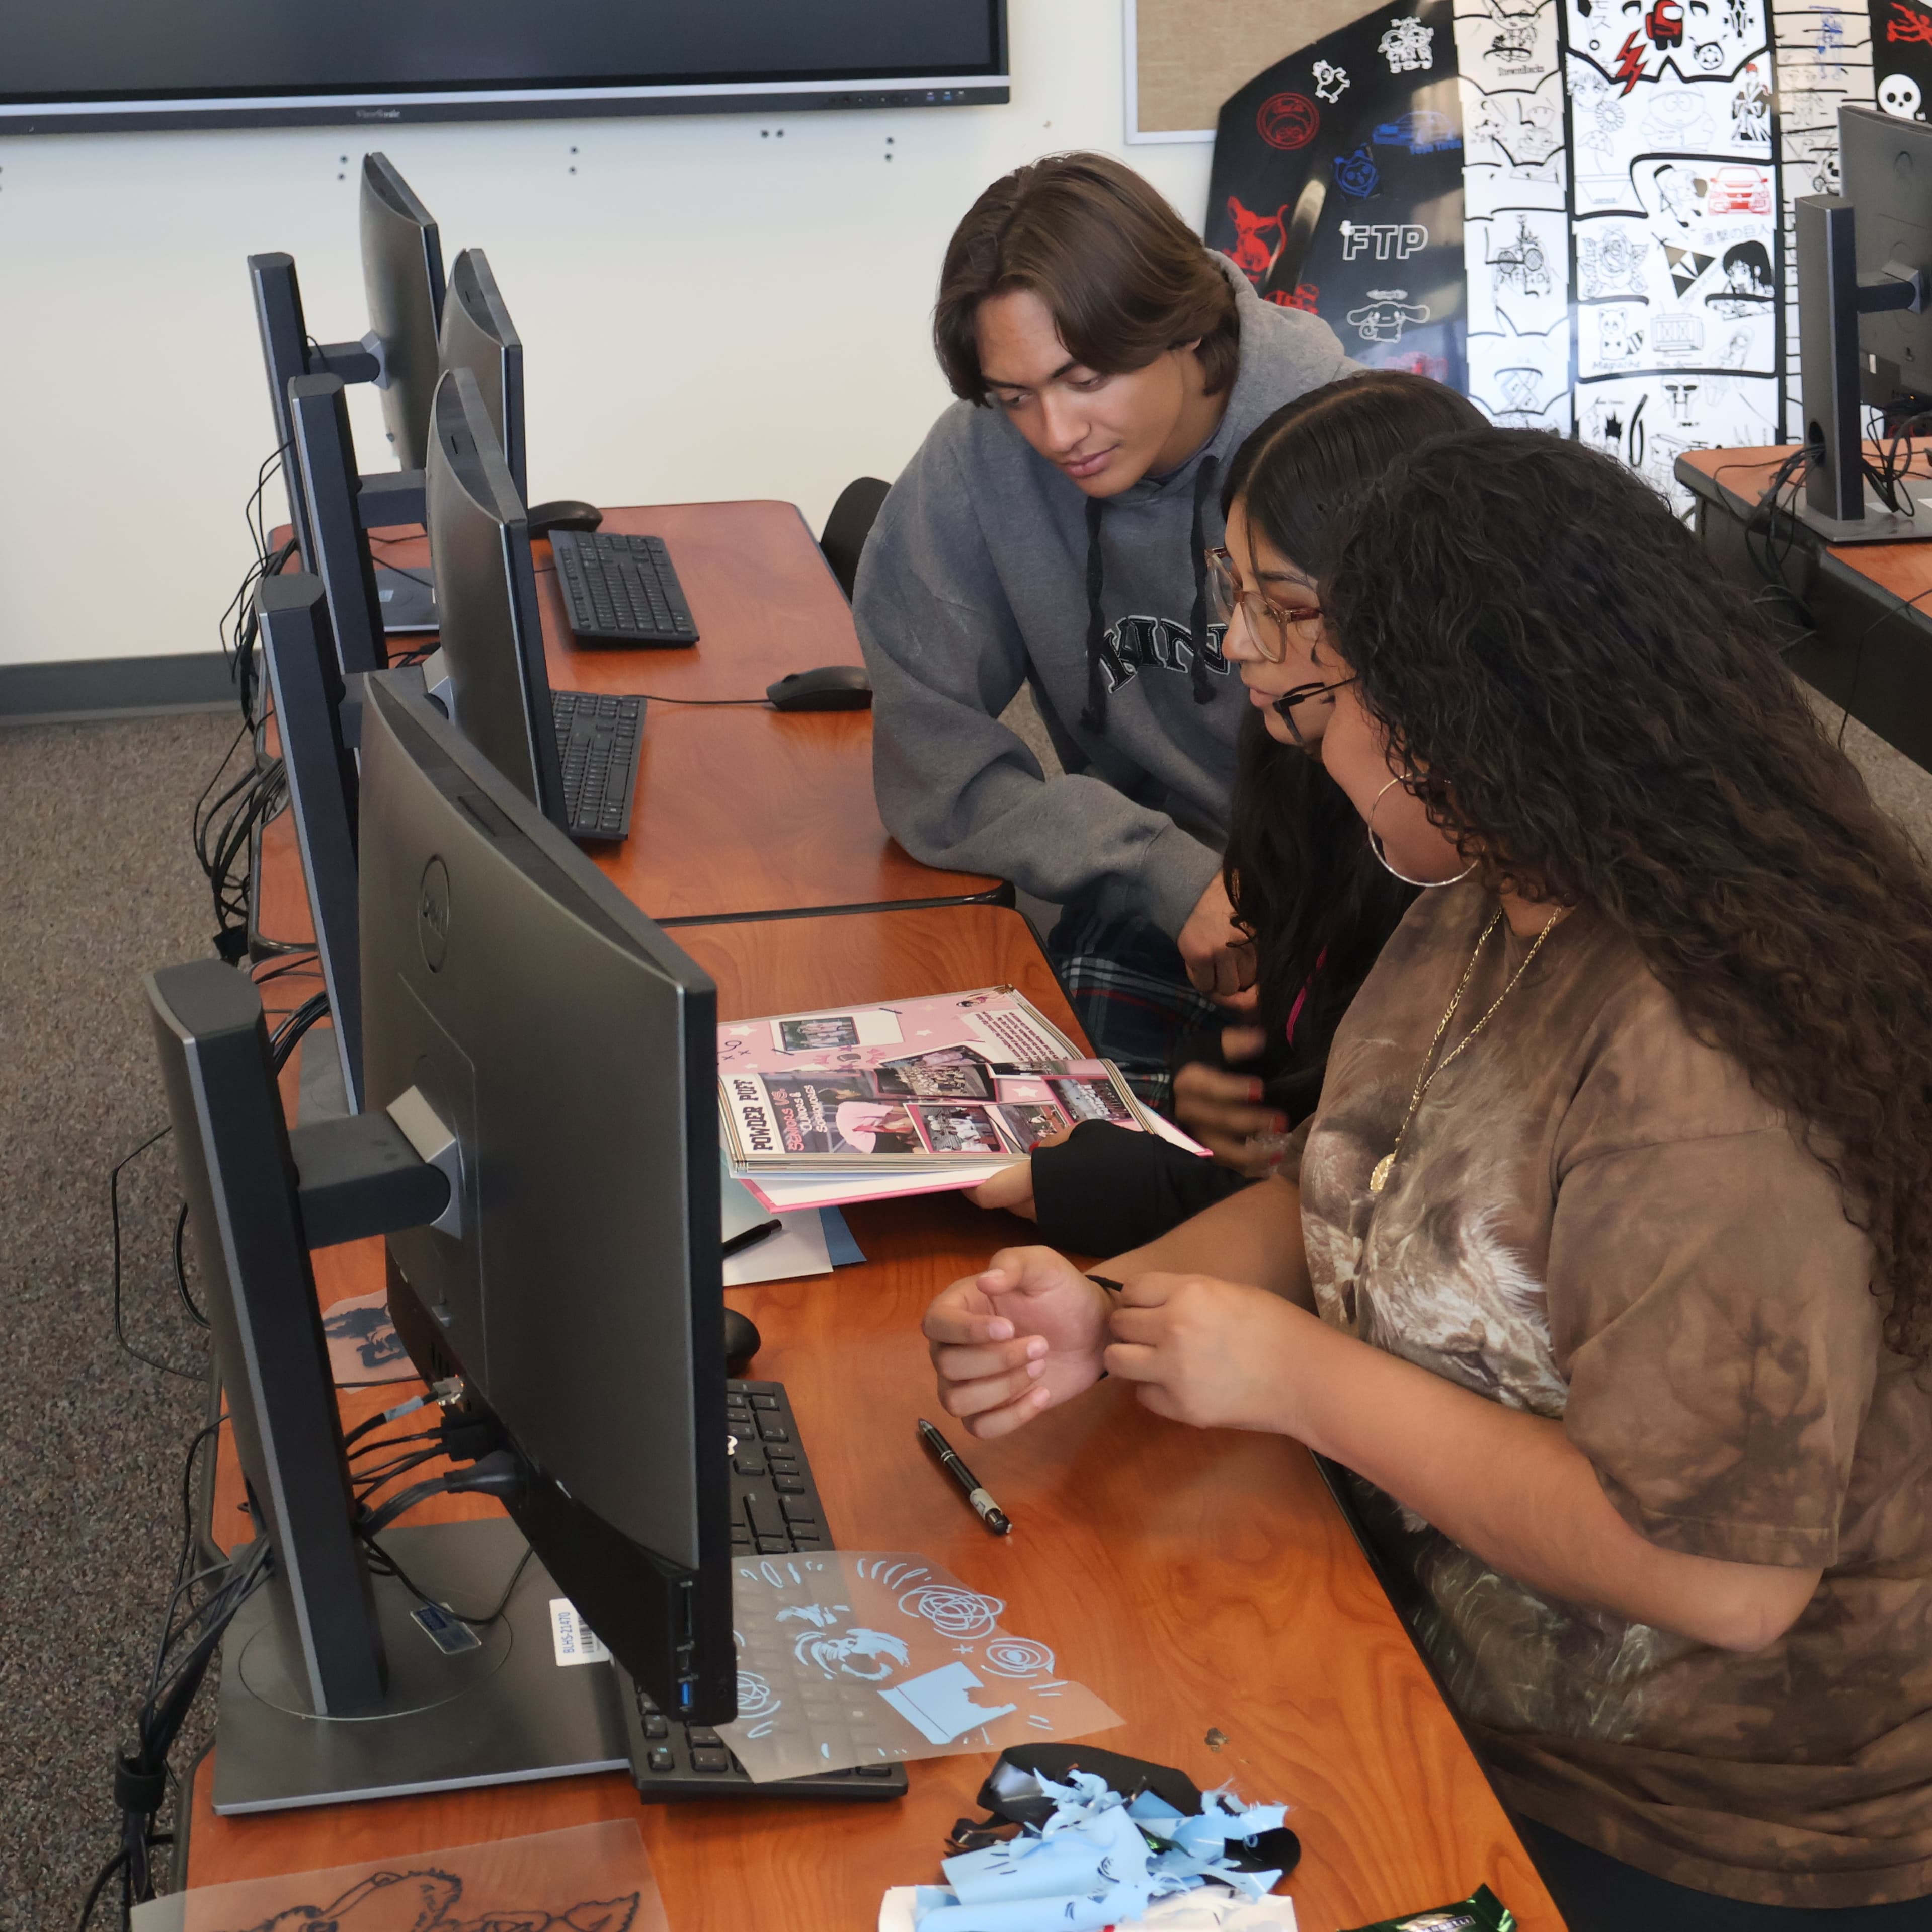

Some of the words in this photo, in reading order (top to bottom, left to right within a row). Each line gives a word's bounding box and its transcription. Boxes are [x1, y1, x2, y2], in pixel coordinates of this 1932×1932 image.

[1342, 224, 1429, 260] FTP
[733, 1079, 759, 1101] PUFF
[804, 1085, 828, 1132] SOPHOMORES
[743, 1107, 773, 1150] POWDER
[781, 1108, 804, 1151] SENIORS
[794, 1098, 813, 1132] JUNIORS
